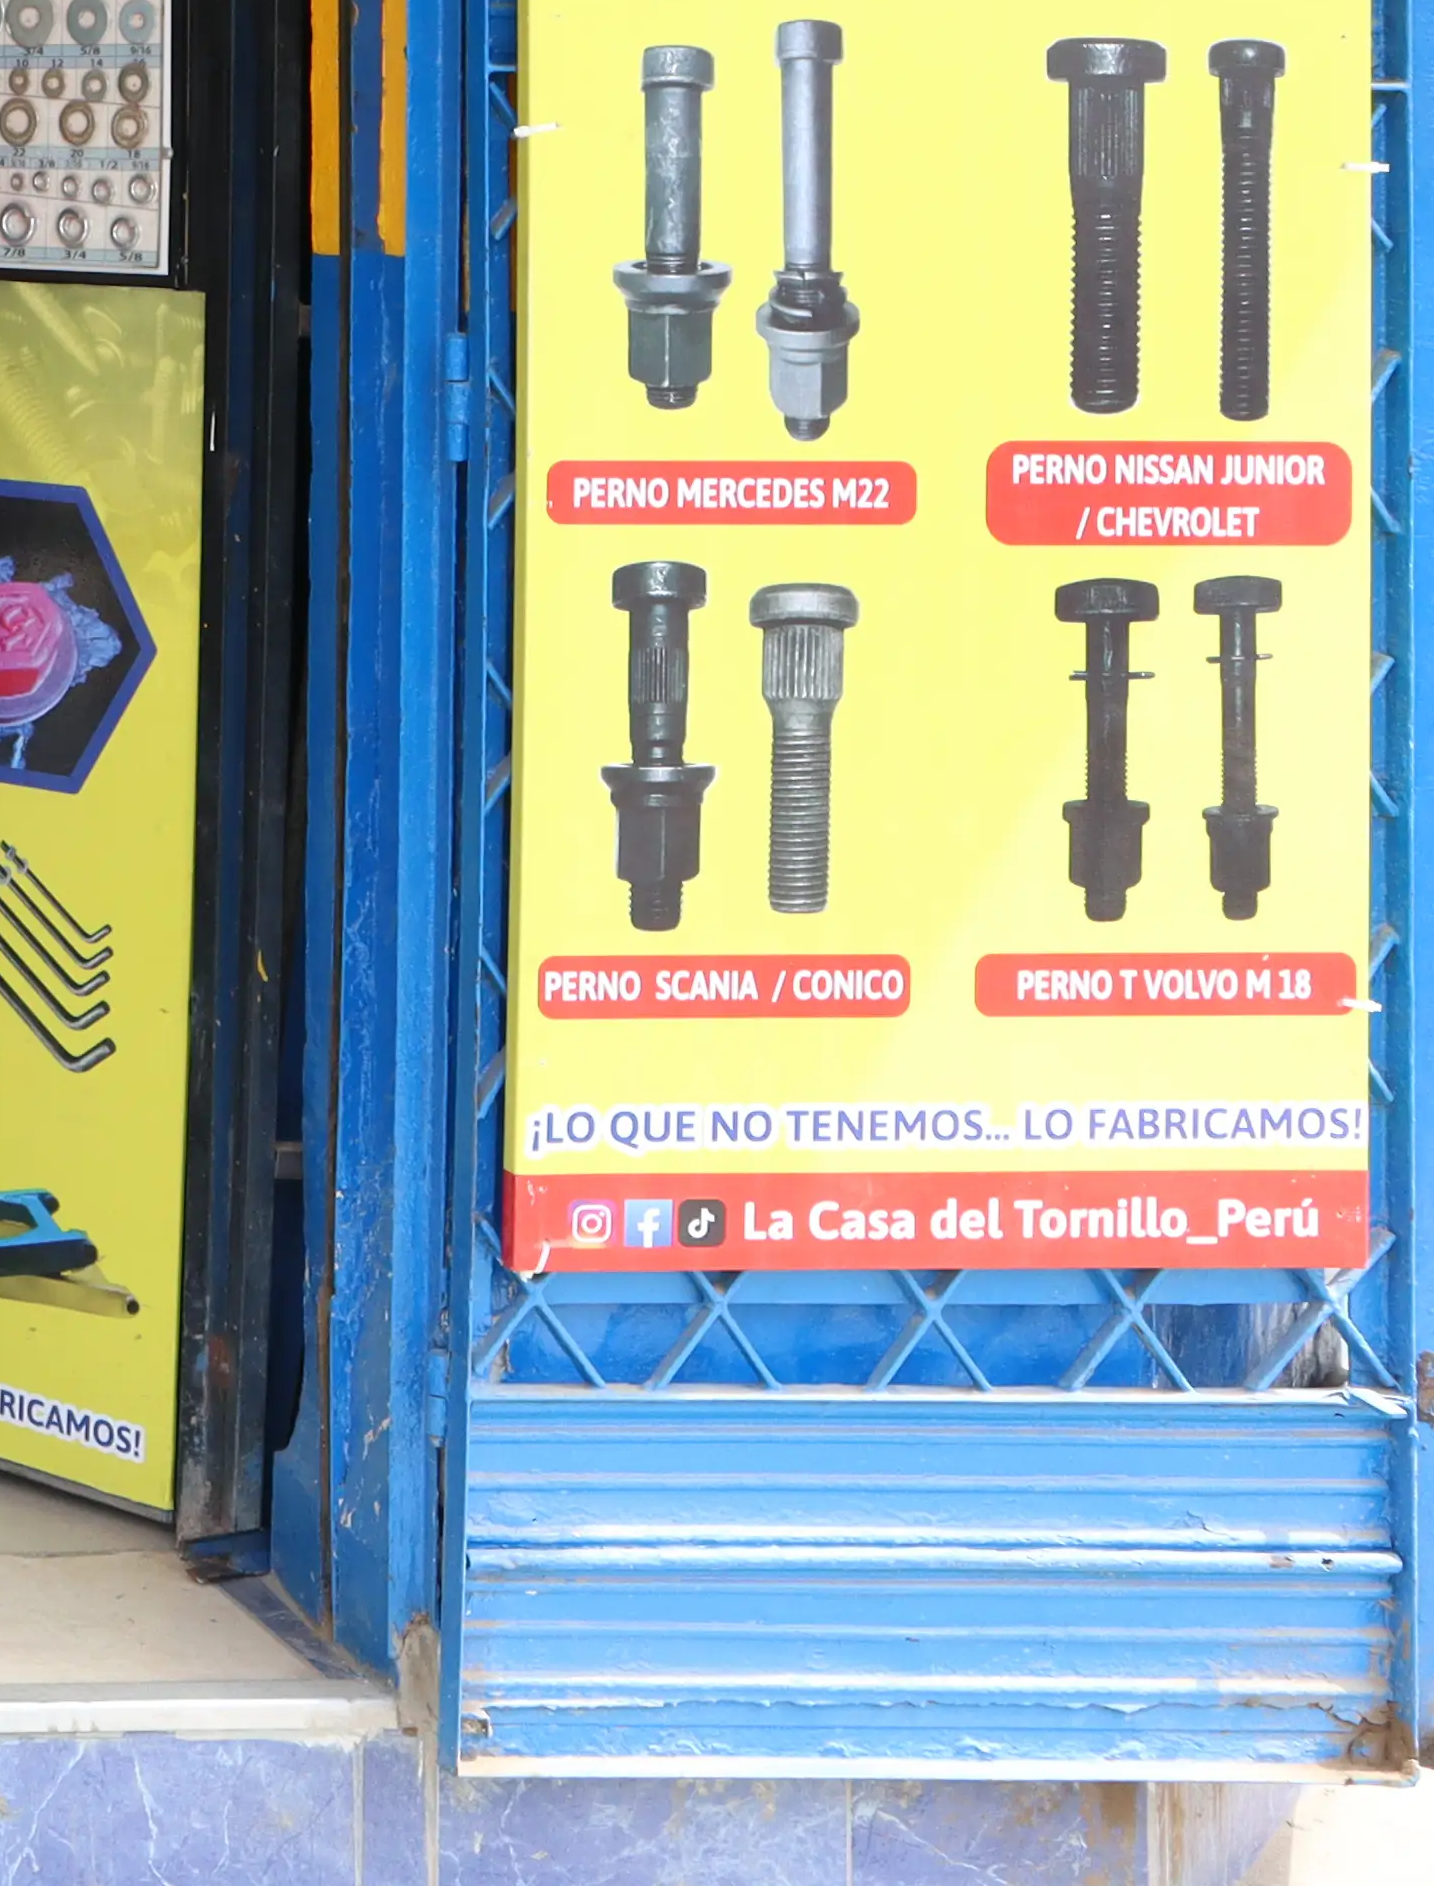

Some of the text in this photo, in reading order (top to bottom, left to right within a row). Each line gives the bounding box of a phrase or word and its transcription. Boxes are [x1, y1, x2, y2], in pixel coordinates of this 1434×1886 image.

[1013, 454, 1325, 485] PERNO NISSAN JUNIOR
[574, 478, 889, 508] PERNO MERCEDES M22
[1097, 507, 1260, 537] CHEVROLET
[545, 970, 641, 1001] PERNO
[655, 970, 758, 1001] SCANIA
[793, 969, 903, 1000] CONICO
[1017, 969, 1311, 1000] PERNO T VOLVO M 18
[531, 1105, 1362, 1152] ¡LO QUE NO TENEMOS... LO FABRICAMOS!
[744, 1196, 1319, 1245] La Casa del Tornillo_Perú
